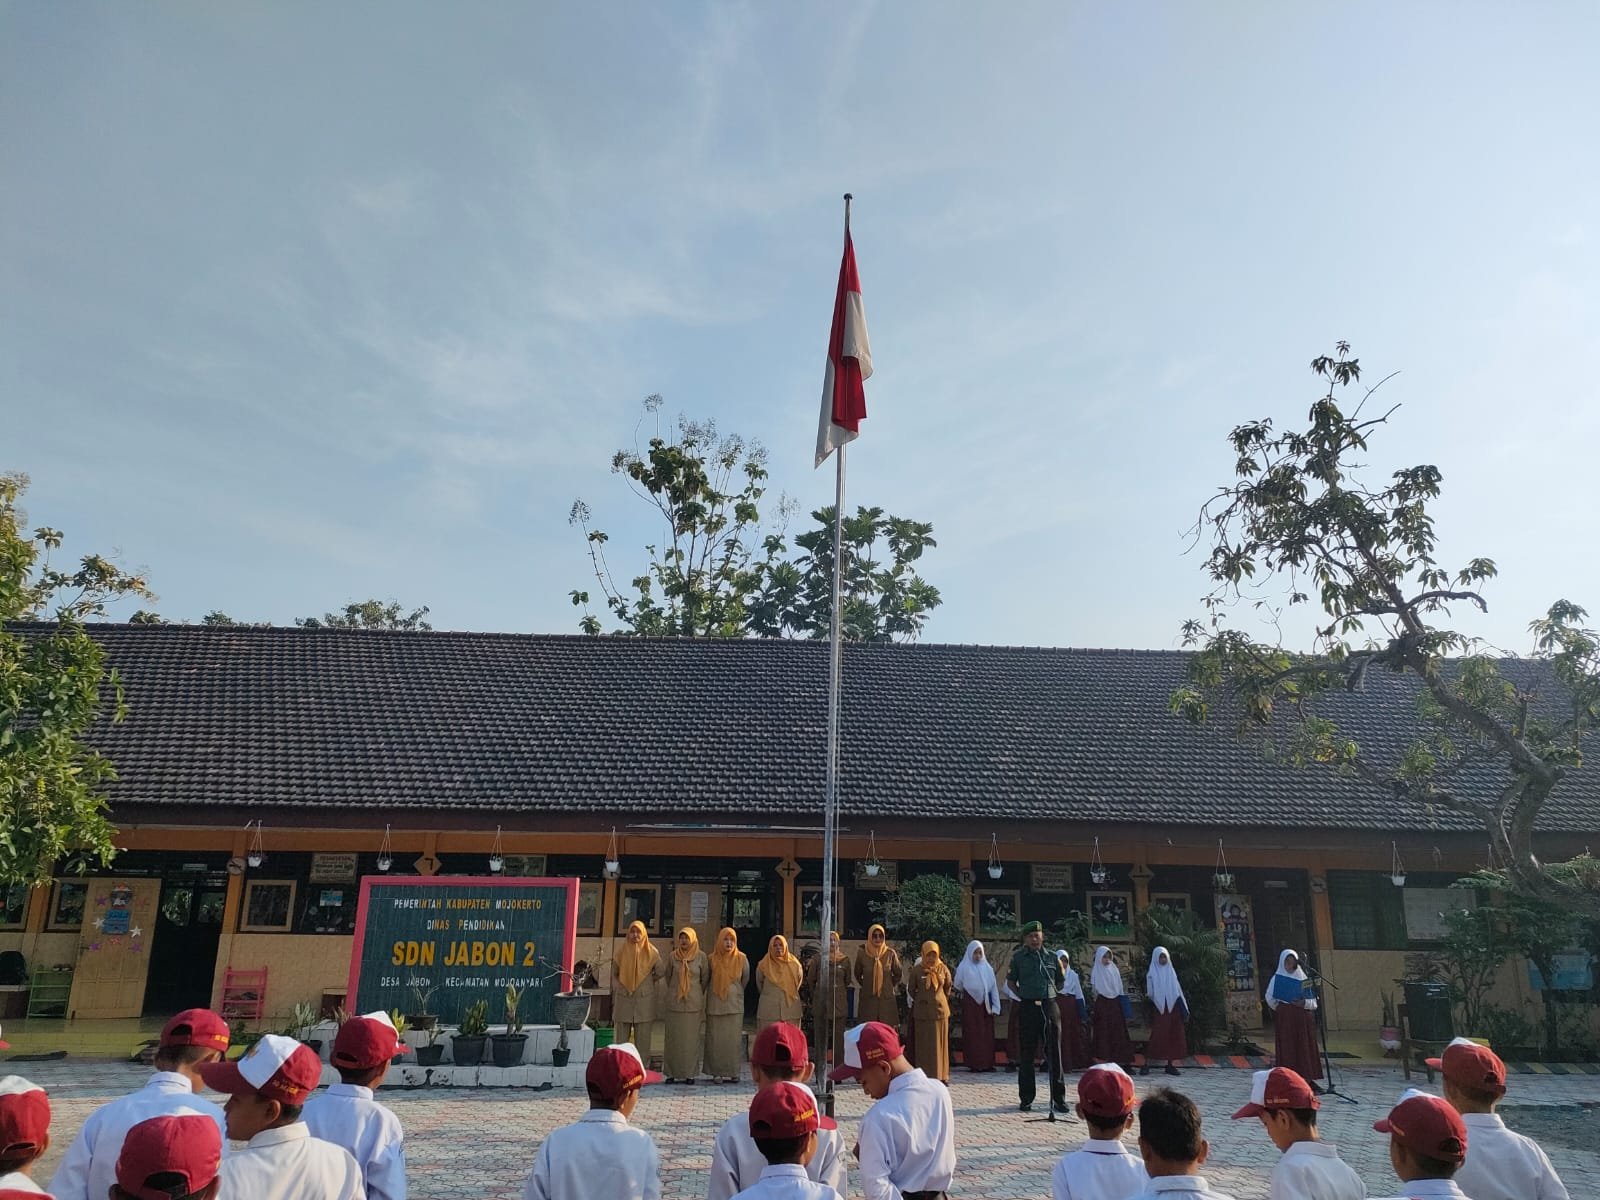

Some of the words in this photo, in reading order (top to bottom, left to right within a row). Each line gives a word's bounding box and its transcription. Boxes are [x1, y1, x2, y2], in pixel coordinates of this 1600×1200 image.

[394, 899, 442, 909] PEMERINTAH
[446, 899, 491, 910] KABUPATEN
[495, 899, 542, 910] MOJOKERTO
[427, 919, 450, 930] DINAS
[458, 919, 505, 931] PENDIDIKAN
[391, 941, 435, 966] SDN
[444, 941, 516, 966] JABON
[522, 941, 535, 966] 2
[380, 976, 400, 987] DESA
[405, 976, 431, 987] JABON
[445, 976, 490, 988] KECAMATAN
